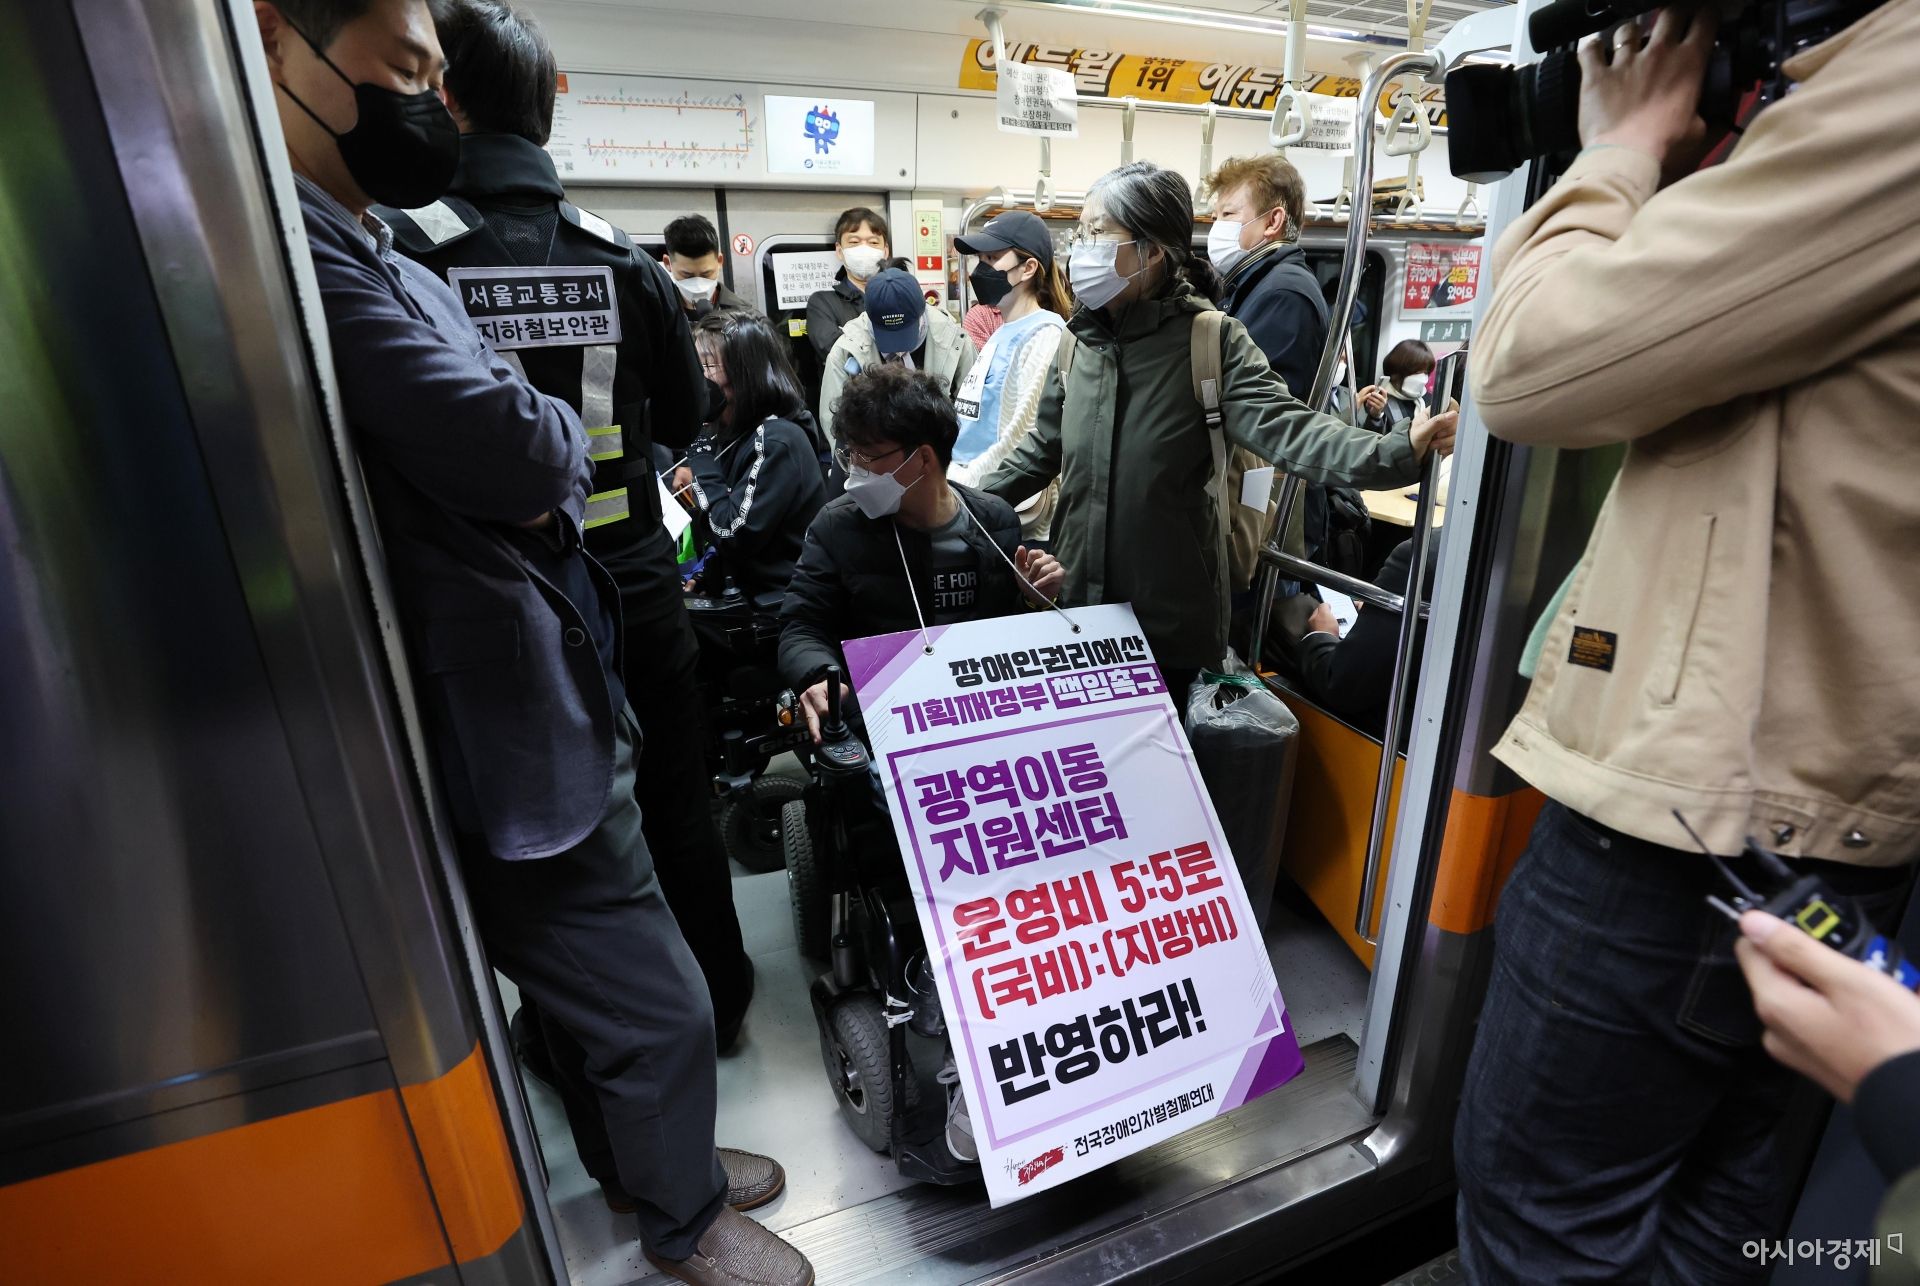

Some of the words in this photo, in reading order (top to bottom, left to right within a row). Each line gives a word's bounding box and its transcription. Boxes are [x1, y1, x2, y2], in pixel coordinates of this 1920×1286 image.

[1136, 66, 1175, 92] 1위
[1022, 109, 1051, 121] 보장하라!
[469, 281, 603, 308] 서울교통공사
[782, 271, 837, 281] 장애인평생교육시
[1407, 286, 1418, 299] 수
[476, 314, 609, 343] 지하철보안관
[949, 571, 977, 588] FOR
[948, 635, 1148, 688] 장애인권리예산
[891, 684, 1049, 735] 기획재정부
[1051, 663, 1163, 709] 책임촉구
[913, 742, 1110, 826] 광역이동
[929, 791, 1129, 883] 지원센터
[952, 870, 1108, 962] 운영비
[1110, 842, 1225, 913] 5:5로
[971, 896, 1239, 1020] (국비):(지방비)
[988, 977, 1207, 1107] 반영하라!
[1073, 1083, 1216, 1157] 전국장애인차별철폐연대
